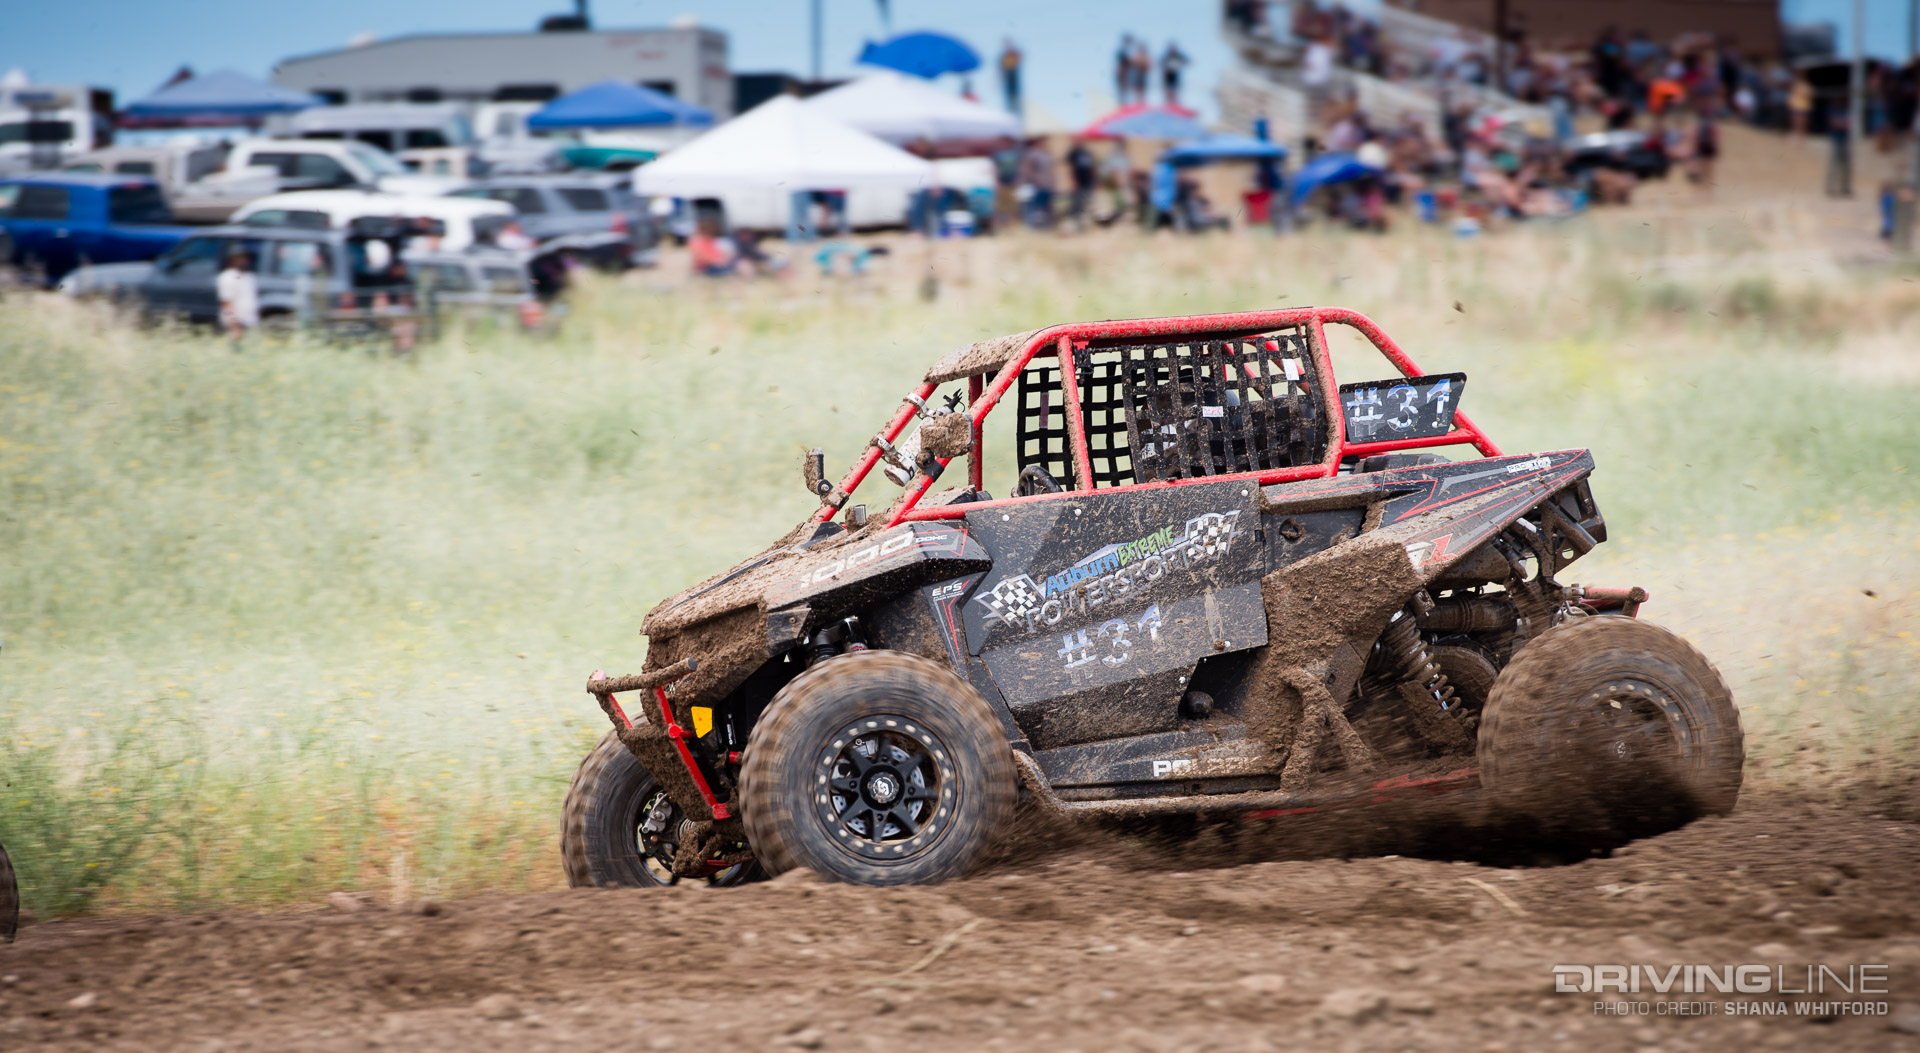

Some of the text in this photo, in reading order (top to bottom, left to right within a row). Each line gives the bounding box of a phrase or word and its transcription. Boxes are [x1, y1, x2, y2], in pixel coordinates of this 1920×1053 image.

[1346, 378, 1451, 438] #31
[915, 534, 948, 543] DOHC
[1046, 525, 1175, 598] Auburn EXTREME
[932, 582, 963, 596] EPS
[1056, 603, 1162, 684] #31
